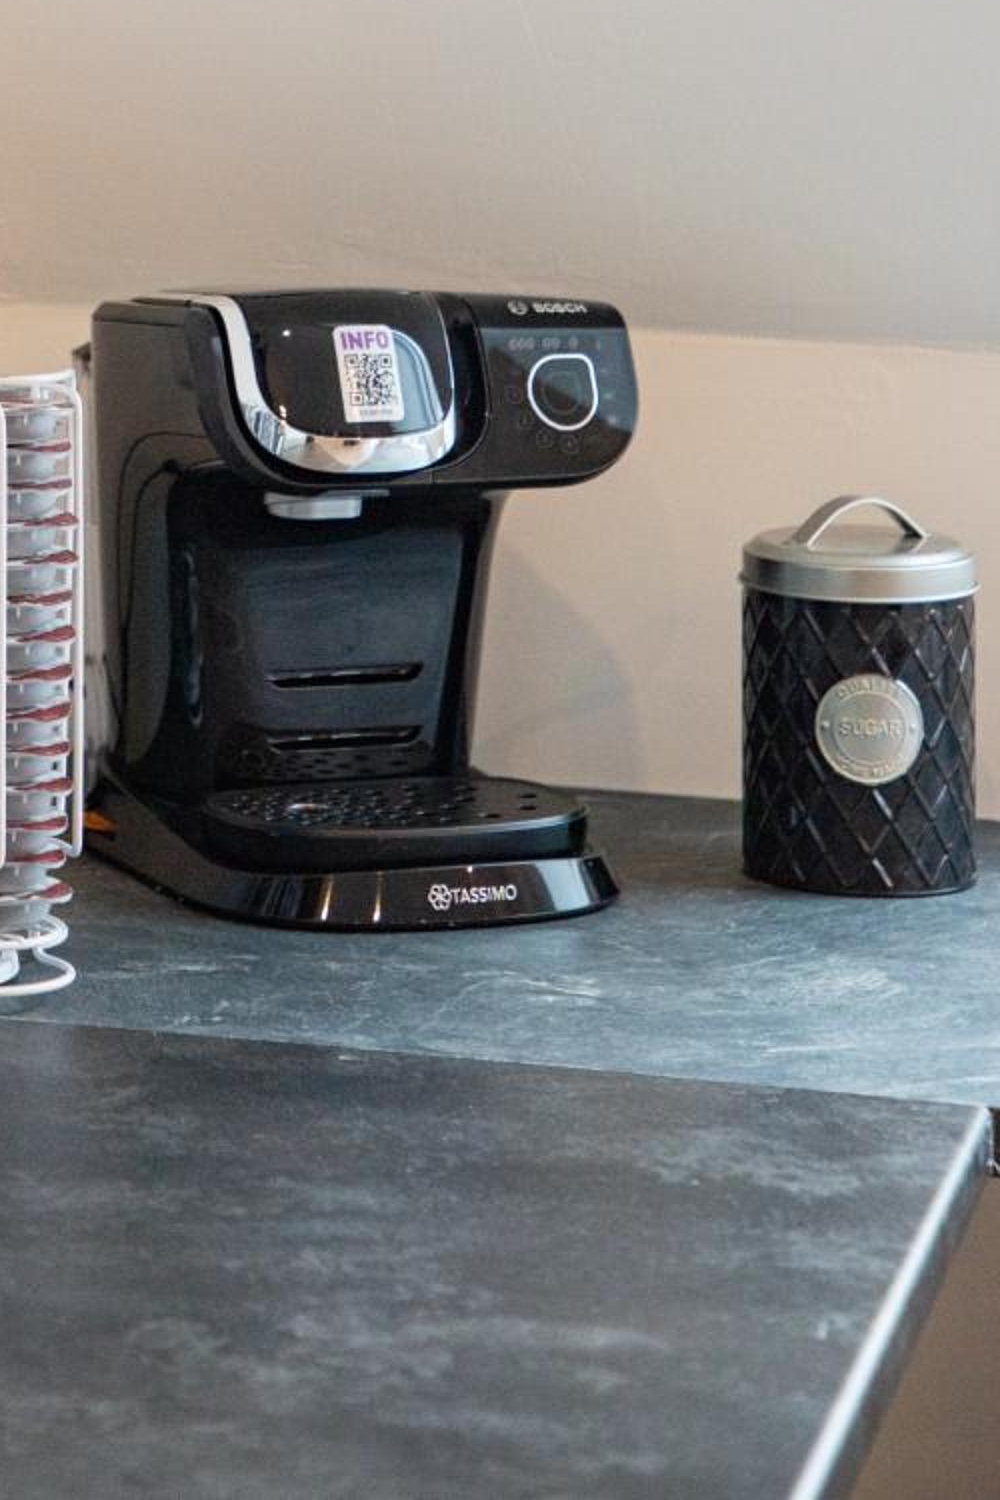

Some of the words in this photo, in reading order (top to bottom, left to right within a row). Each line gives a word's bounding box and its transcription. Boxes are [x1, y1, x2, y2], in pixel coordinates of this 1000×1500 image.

[532, 302, 588, 314] BOSCH
[340, 331, 390, 350] INFO
[838, 718, 904, 739] SUGAR
[450, 884, 518, 904] TASSIMO
